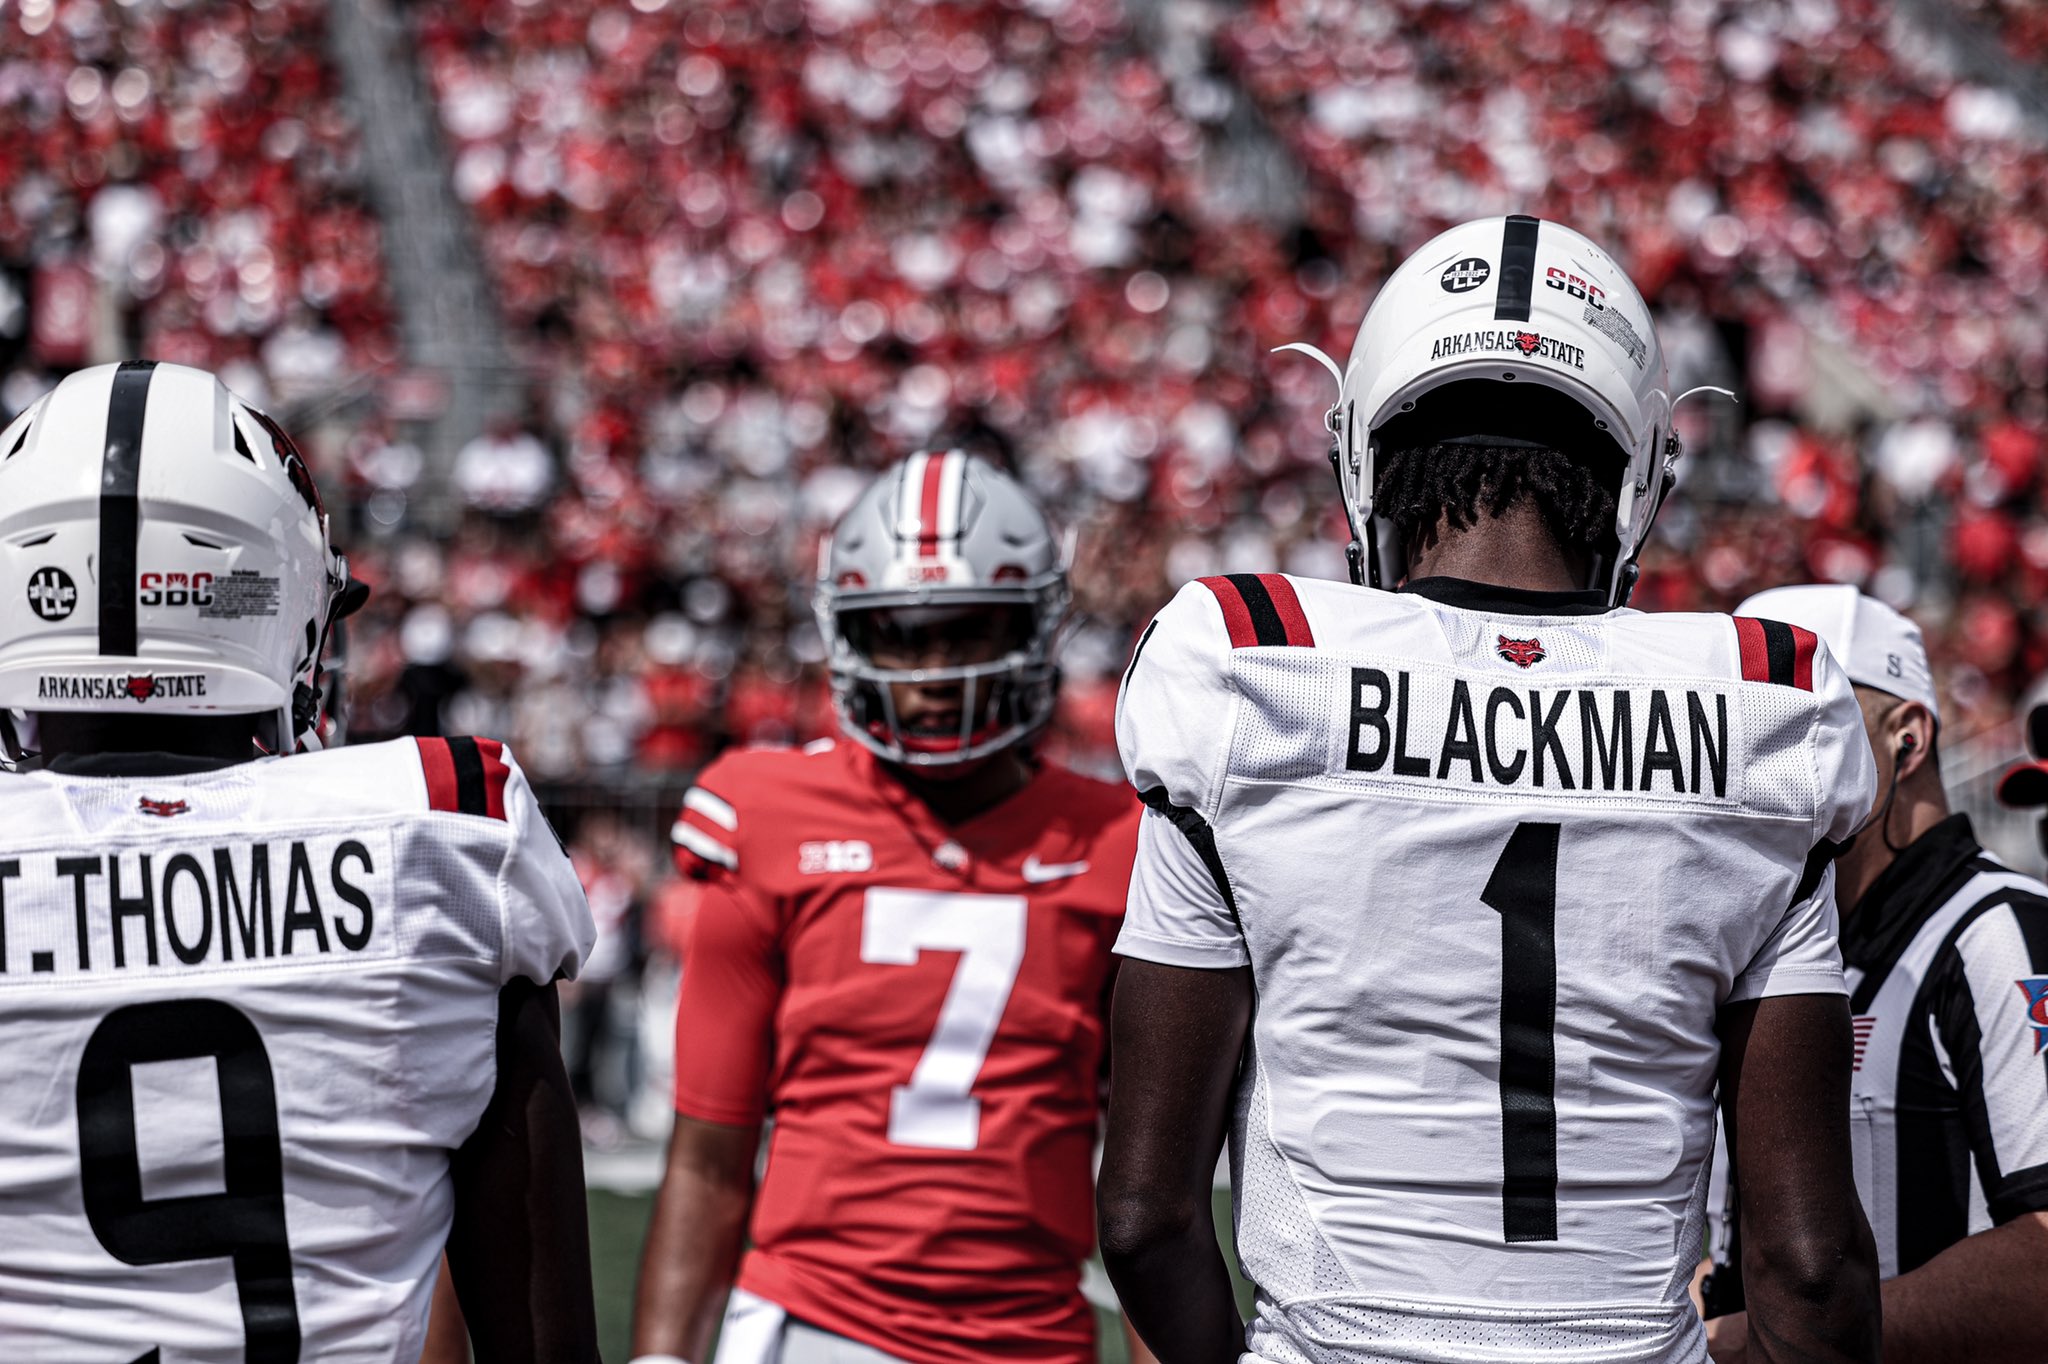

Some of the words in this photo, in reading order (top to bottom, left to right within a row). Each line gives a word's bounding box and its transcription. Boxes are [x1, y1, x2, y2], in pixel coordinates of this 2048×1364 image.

[1546, 267, 1605, 311] SBC
[1431, 331, 1515, 360] ARKANSAS
[1540, 336, 1584, 370] STATE
[140, 573, 213, 605] SBC
[38, 676, 126, 699] ARKANSAS
[154, 675, 206, 697] STATE
[1887, 654, 1902, 678] S
[1346, 667, 1727, 797] BLACKMAN
[860, 886, 1028, 1150] 7
[1479, 822, 1561, 1242] 1
[76, 998, 301, 1364] 9
